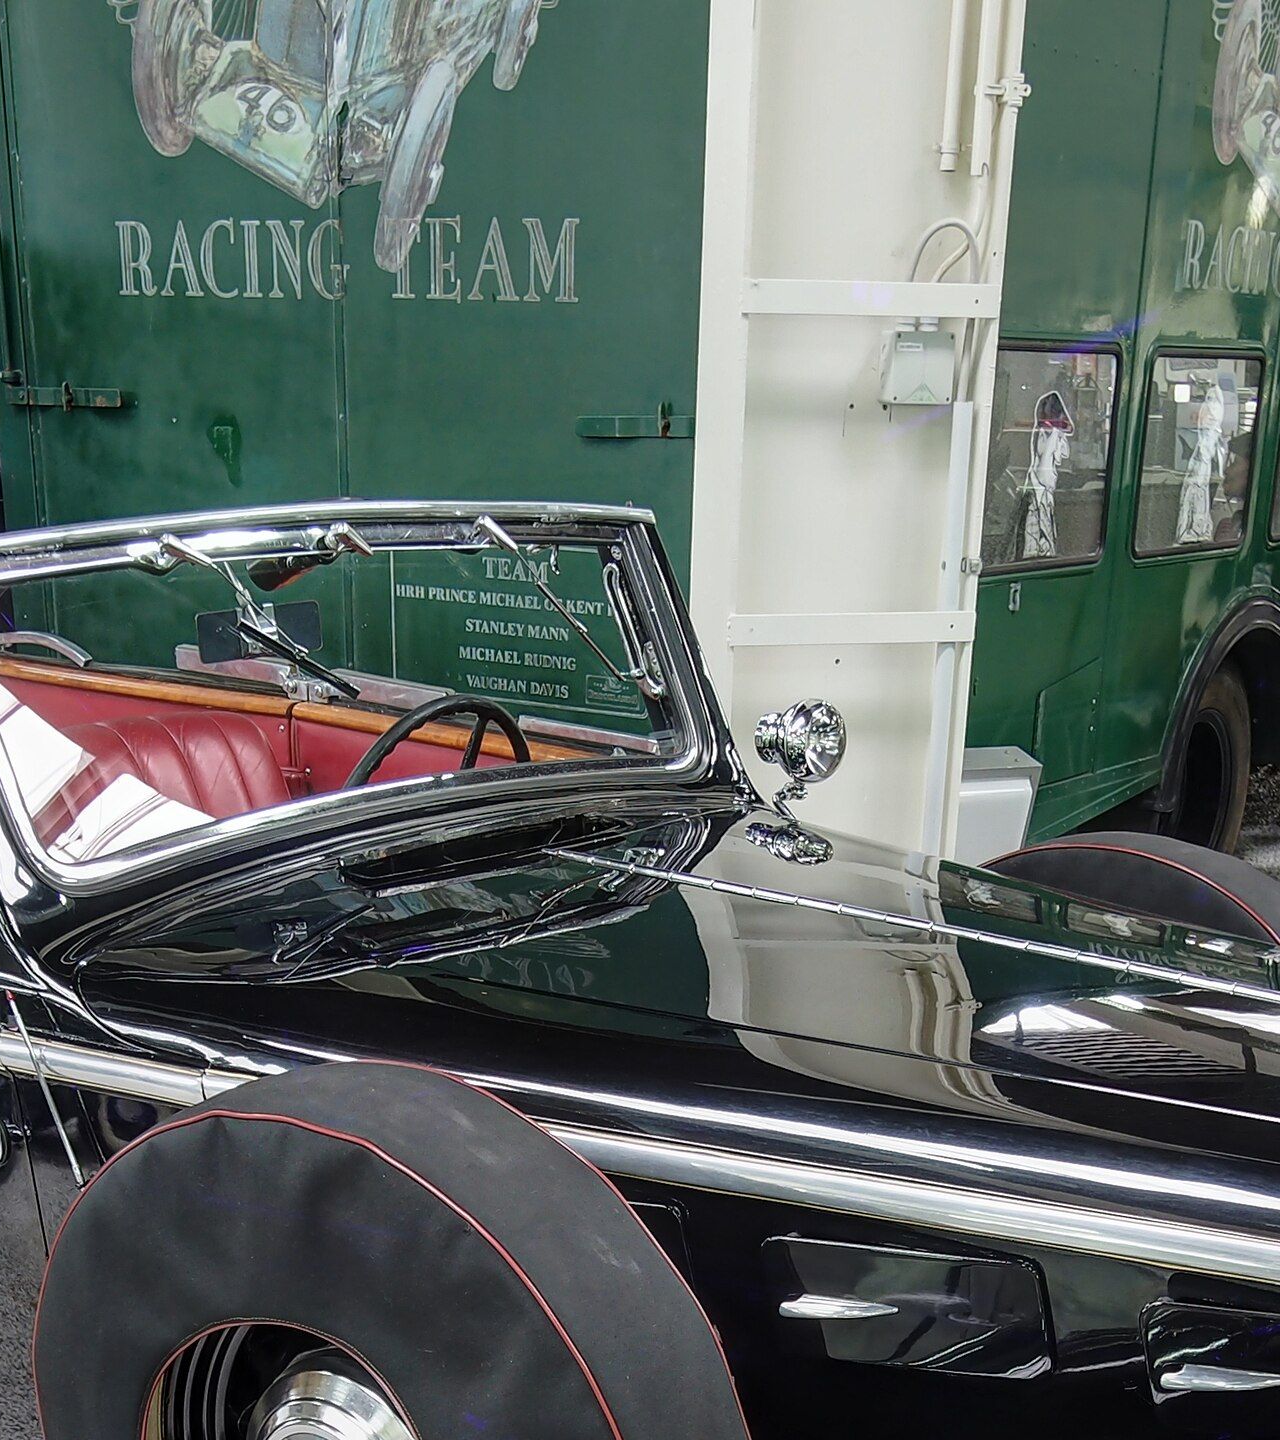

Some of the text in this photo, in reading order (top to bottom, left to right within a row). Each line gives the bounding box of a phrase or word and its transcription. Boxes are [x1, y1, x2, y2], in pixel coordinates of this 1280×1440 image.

[114, 214, 581, 304] RACING TEAM
[482, 556, 550, 584] TEAM
[396, 584, 425, 600] HRH
[428, 587, 477, 605] PRINCE
[479, 592, 542, 611] MICHAEL
[566, 600, 604, 616] KENT
[465, 618, 570, 642] STANLEY MANN
[458, 645, 577, 671] MICHAEL RUDNIG
[466, 674, 570, 699] VAUGHAN DAVIS
